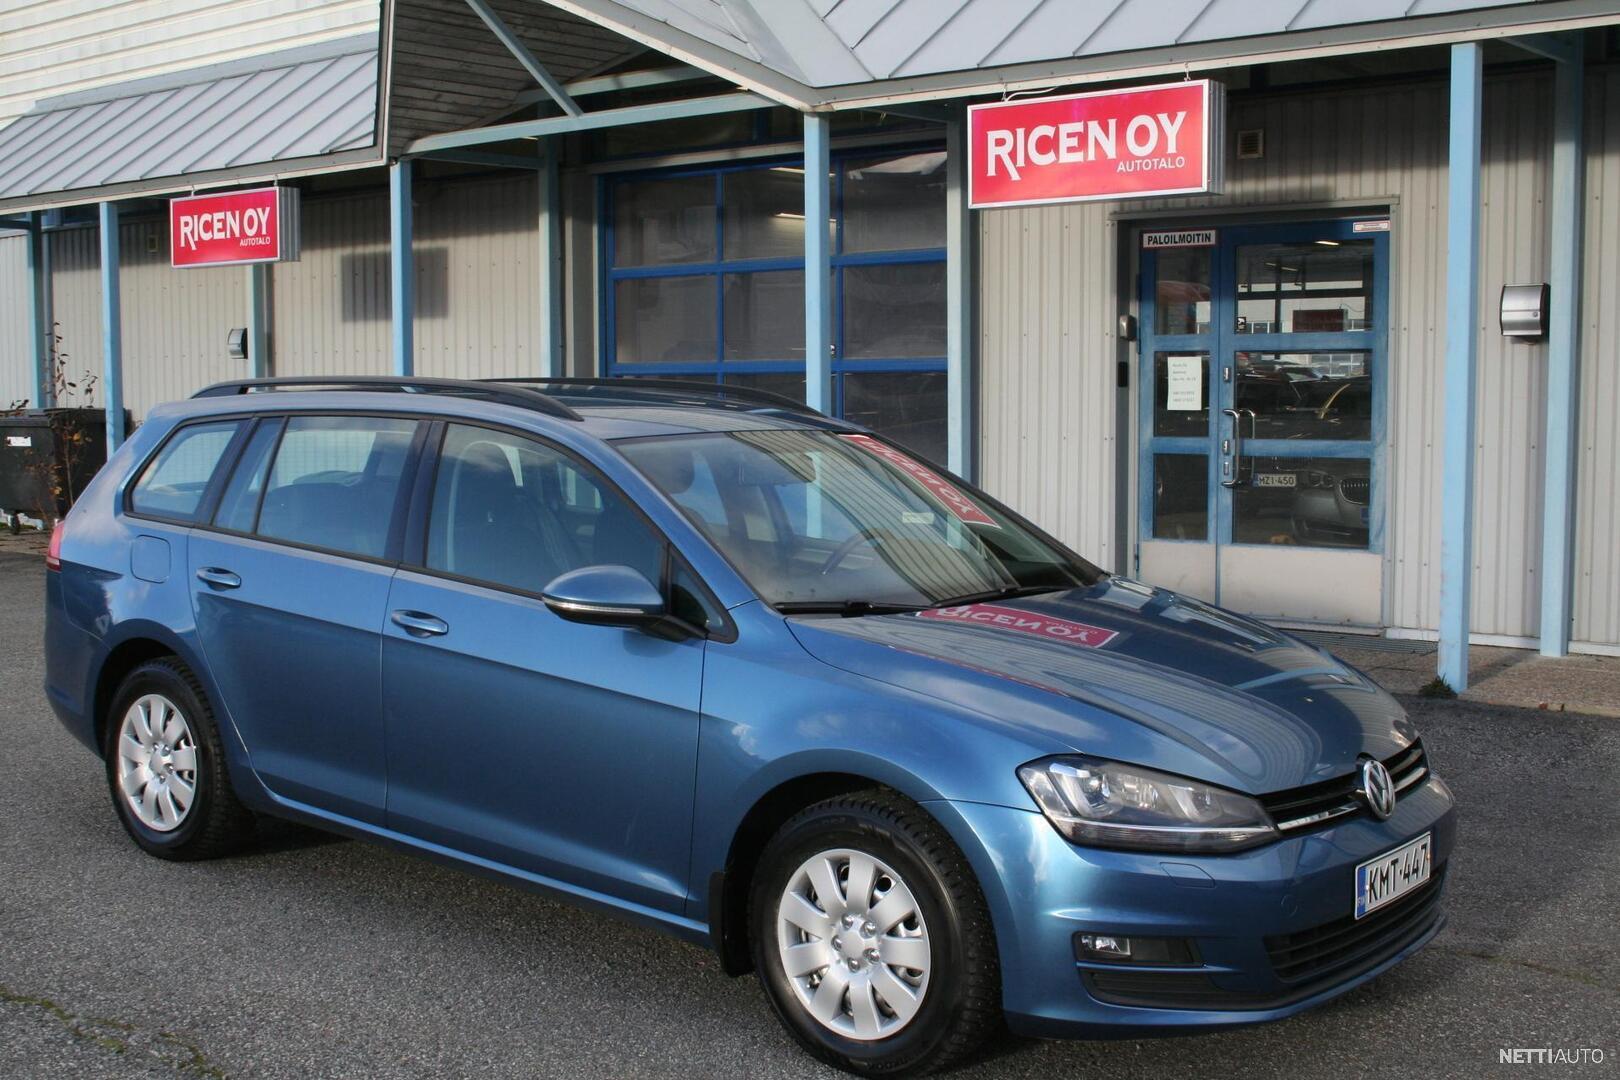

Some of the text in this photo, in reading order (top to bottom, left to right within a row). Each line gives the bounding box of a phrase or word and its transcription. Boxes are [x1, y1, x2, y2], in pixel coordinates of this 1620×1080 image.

[986, 111, 1187, 181] RICEN OY
[1116, 156, 1186, 173] AUTOTALO
[180, 207, 271, 250] RICEN OY
[239, 236, 271, 247] AUTOTALO
[1147, 232, 1212, 246] PALOILMOITIN
[1368, 843, 1428, 904] KMT-447
